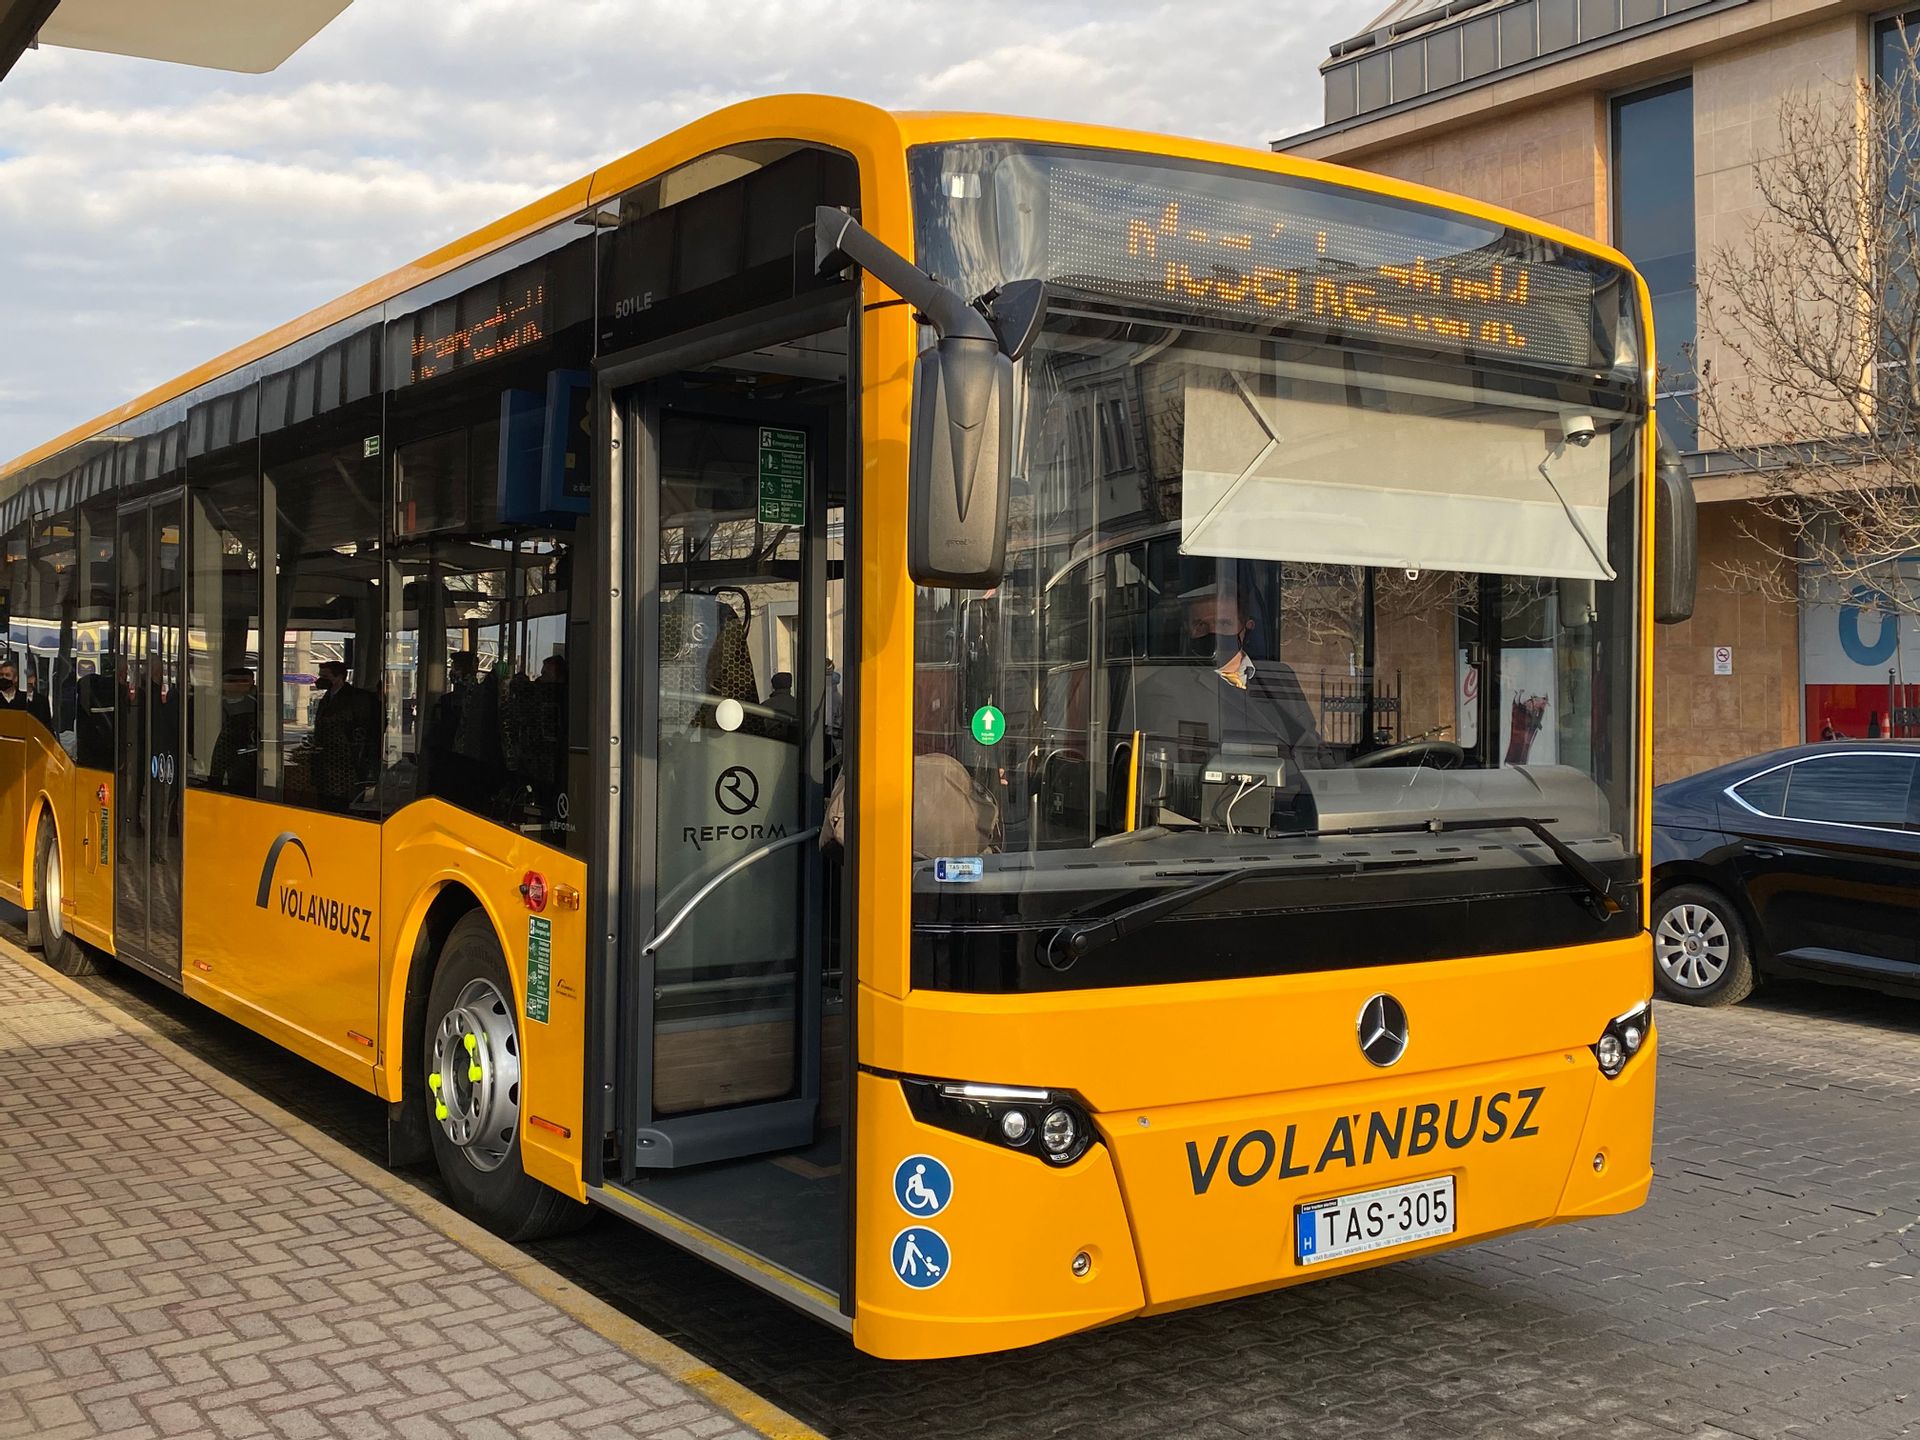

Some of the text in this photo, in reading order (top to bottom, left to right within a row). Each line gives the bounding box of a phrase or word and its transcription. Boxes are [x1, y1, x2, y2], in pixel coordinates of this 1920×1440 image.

[683, 823, 787, 851] REFORM
[280, 885, 372, 942] VOLÁNBUSZ
[1185, 1086, 1546, 1195] VOLÁNBUSZ
[1303, 1236, 1312, 1250] H
[1323, 1189, 1447, 1246] TAS-305
